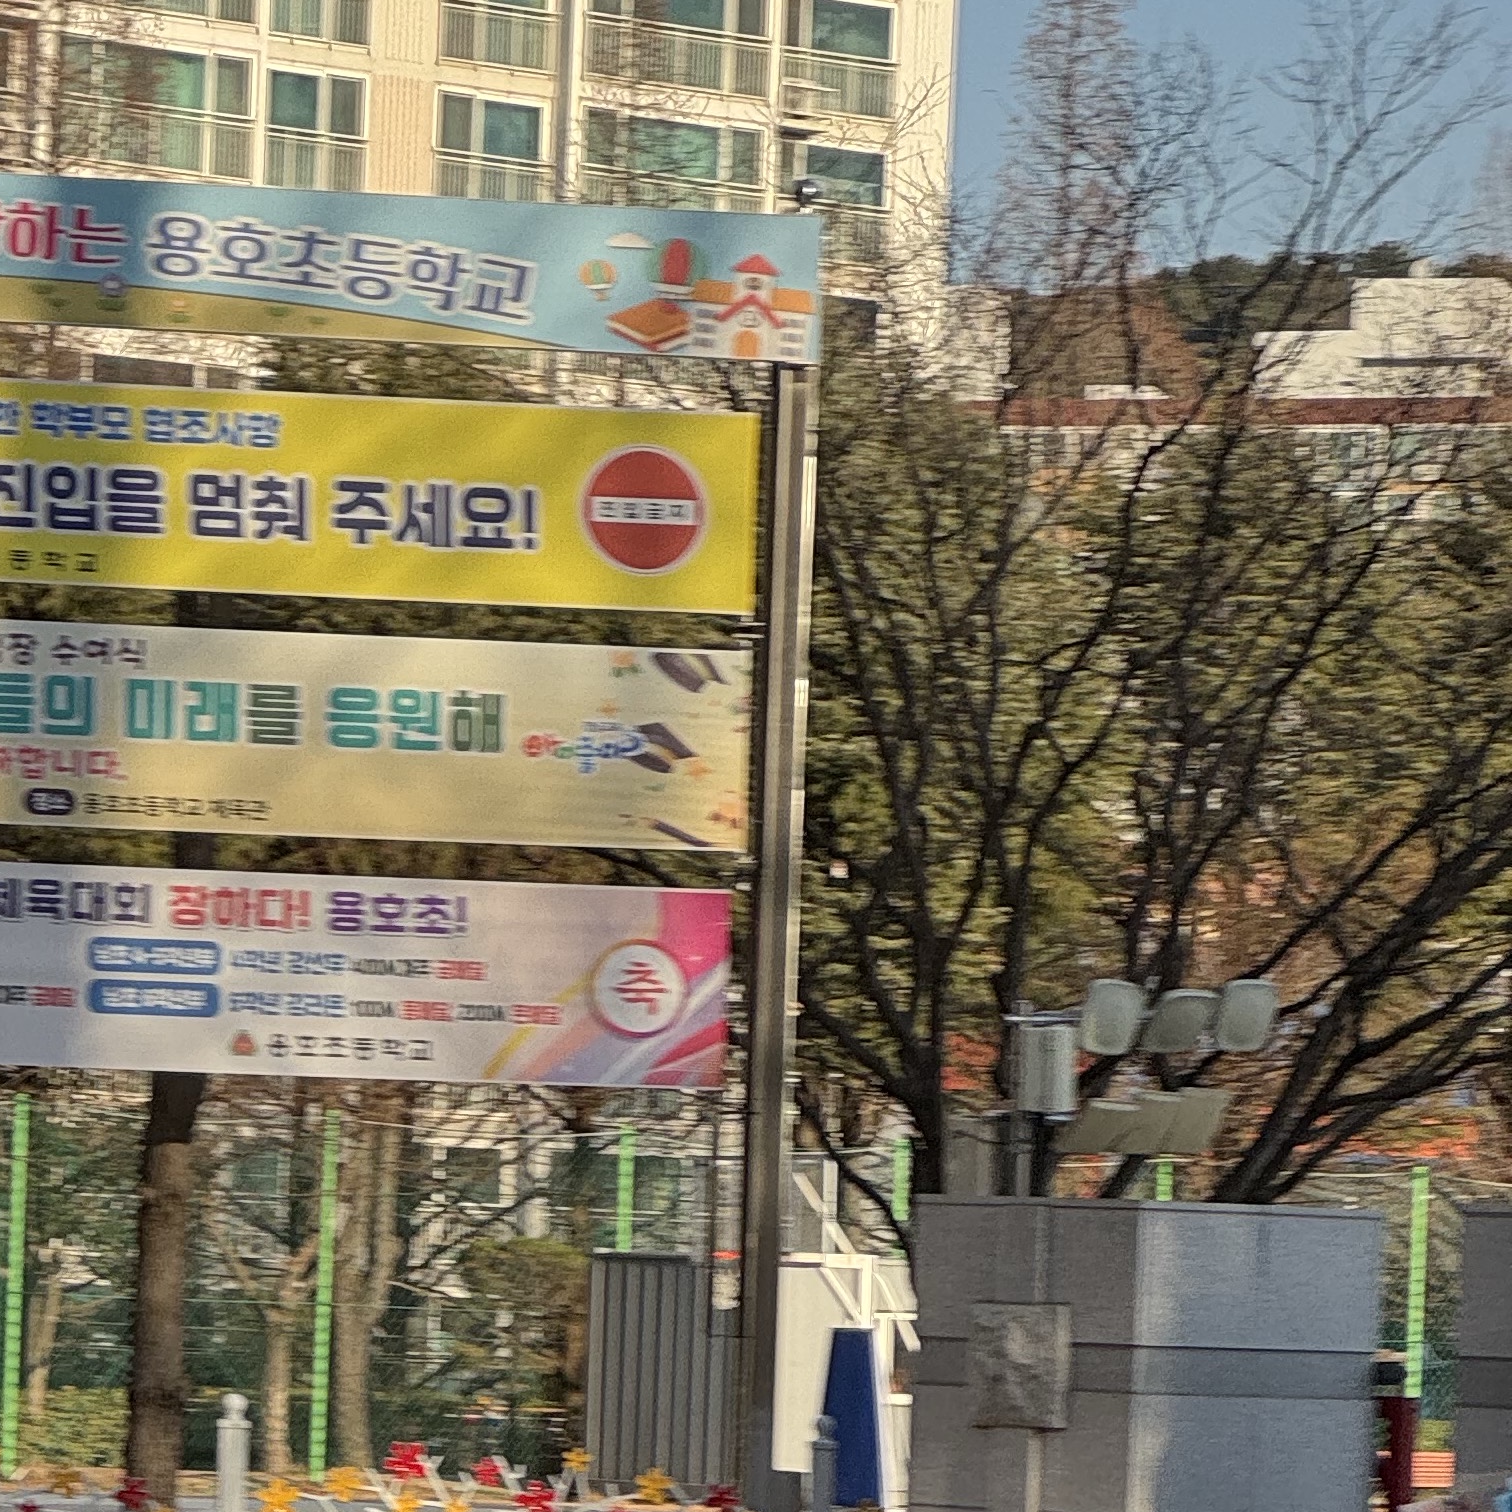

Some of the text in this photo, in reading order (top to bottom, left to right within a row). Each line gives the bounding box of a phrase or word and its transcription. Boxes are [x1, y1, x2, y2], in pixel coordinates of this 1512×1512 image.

[147, 214, 536, 320] 용호초등학교
[32, 402, 130, 440] 학부모
[144, 407, 282, 448] 협조사항
[191, 473, 310, 542] 멈춰
[333, 479, 539, 552] 주세요!
[52, 635, 147, 669] 수여식
[126, 679, 299, 745] 미래를
[327, 686, 504, 753] 응원해
[82, 792, 205, 817] 용호초등학교
[169, 885, 311, 931] 장하다!
[327, 890, 468, 936] 용호초!
[615, 960, 672, 1016] 축
[269, 1033, 434, 1061] 용호초등학교
